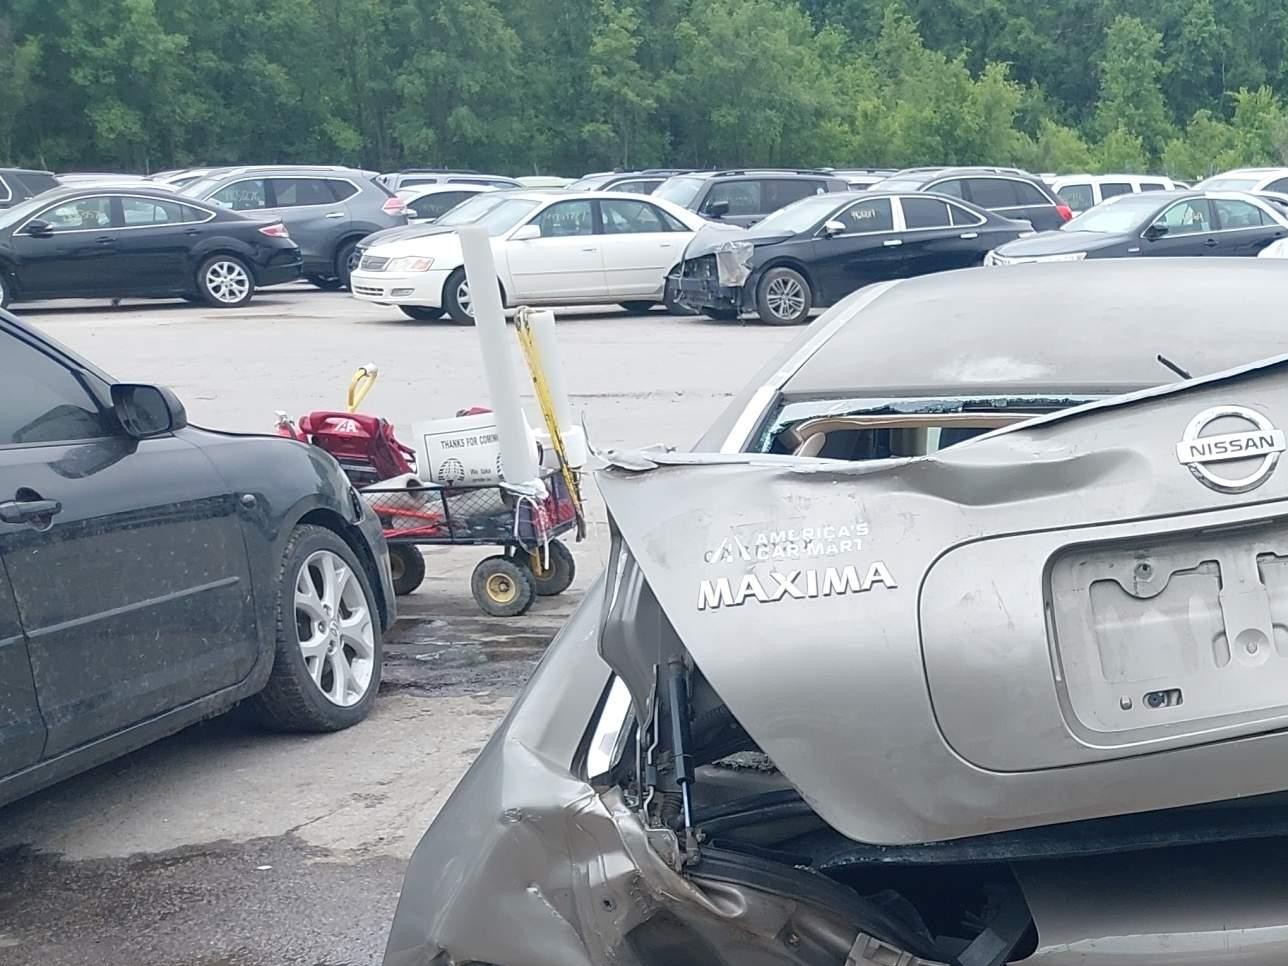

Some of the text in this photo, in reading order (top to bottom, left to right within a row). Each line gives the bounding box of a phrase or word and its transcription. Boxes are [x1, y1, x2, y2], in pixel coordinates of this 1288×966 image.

[440, 433, 499, 449] THANKS FOR COMIN
[1189, 434, 1275, 458] NISSAN
[756, 522, 869, 545] AMERICA'S
[697, 560, 898, 611] MAXIMA
